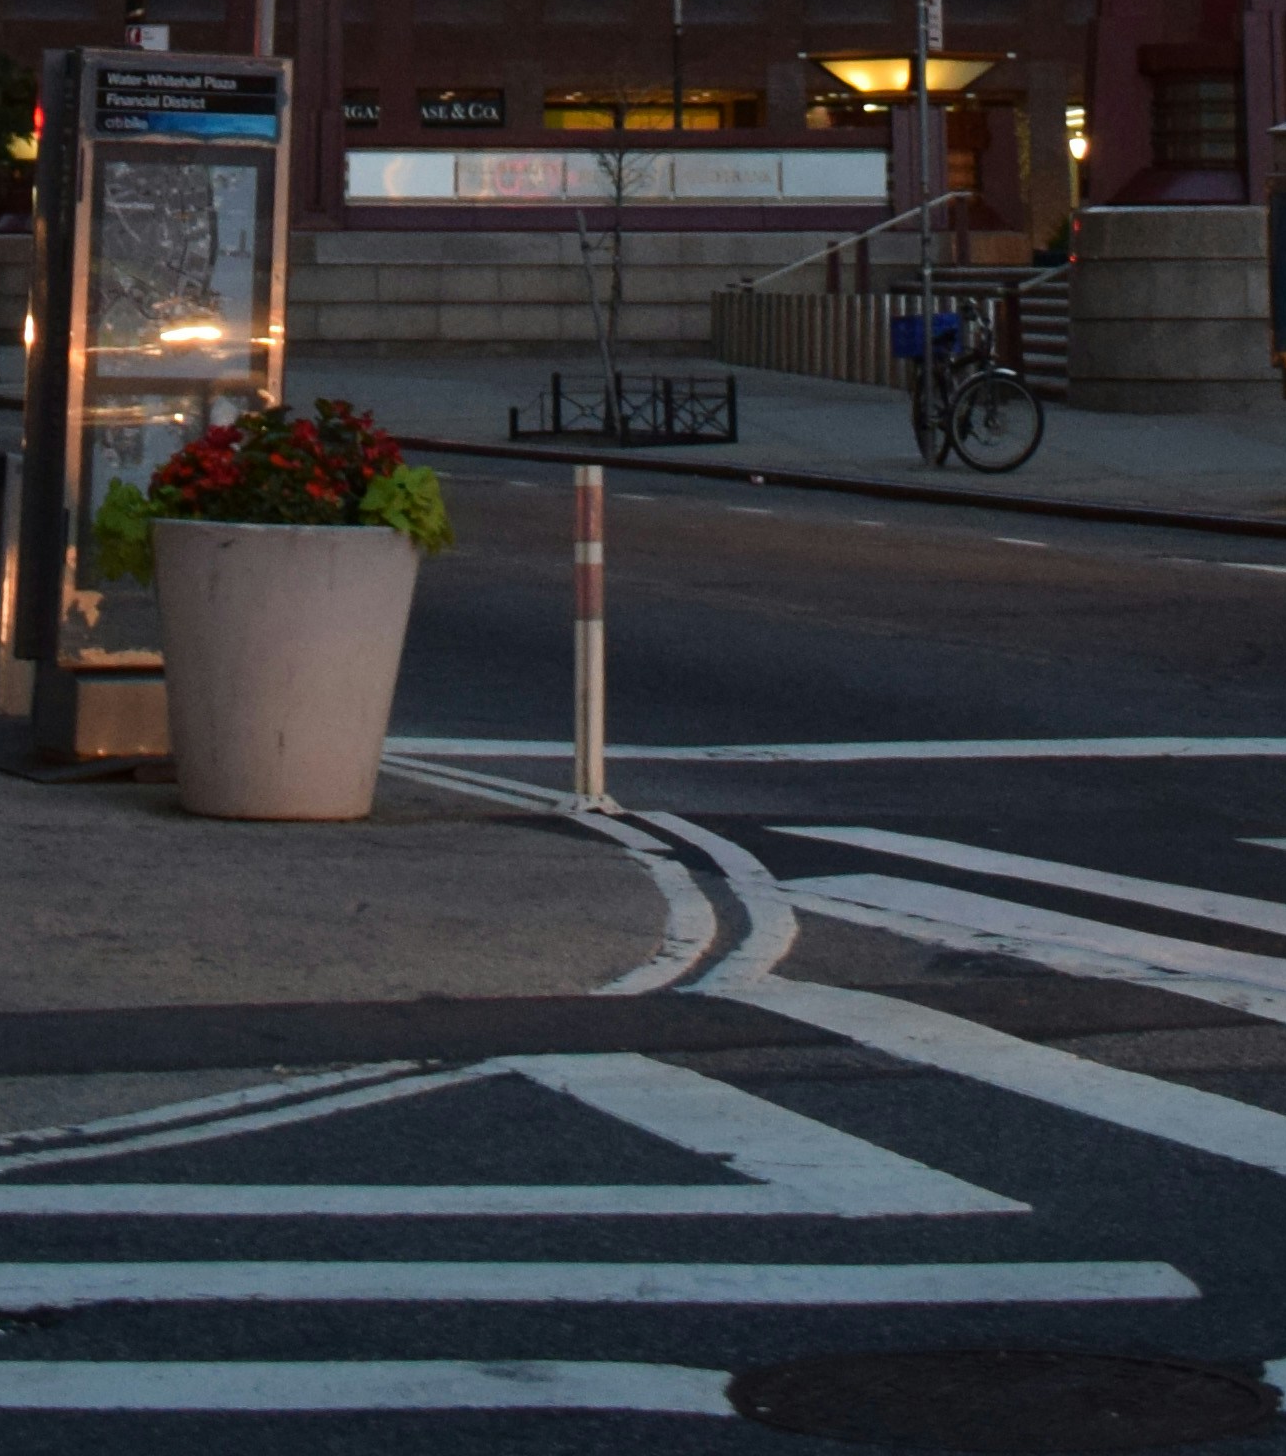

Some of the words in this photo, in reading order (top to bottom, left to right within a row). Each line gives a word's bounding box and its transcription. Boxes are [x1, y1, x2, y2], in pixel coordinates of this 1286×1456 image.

[107, 71, 202, 89] Water-Whitehall
[203, 75, 237, 91] Plaza
[106, 92, 160, 108] Financial
[162, 94, 206, 110] District
[450, 102, 465, 120] &
